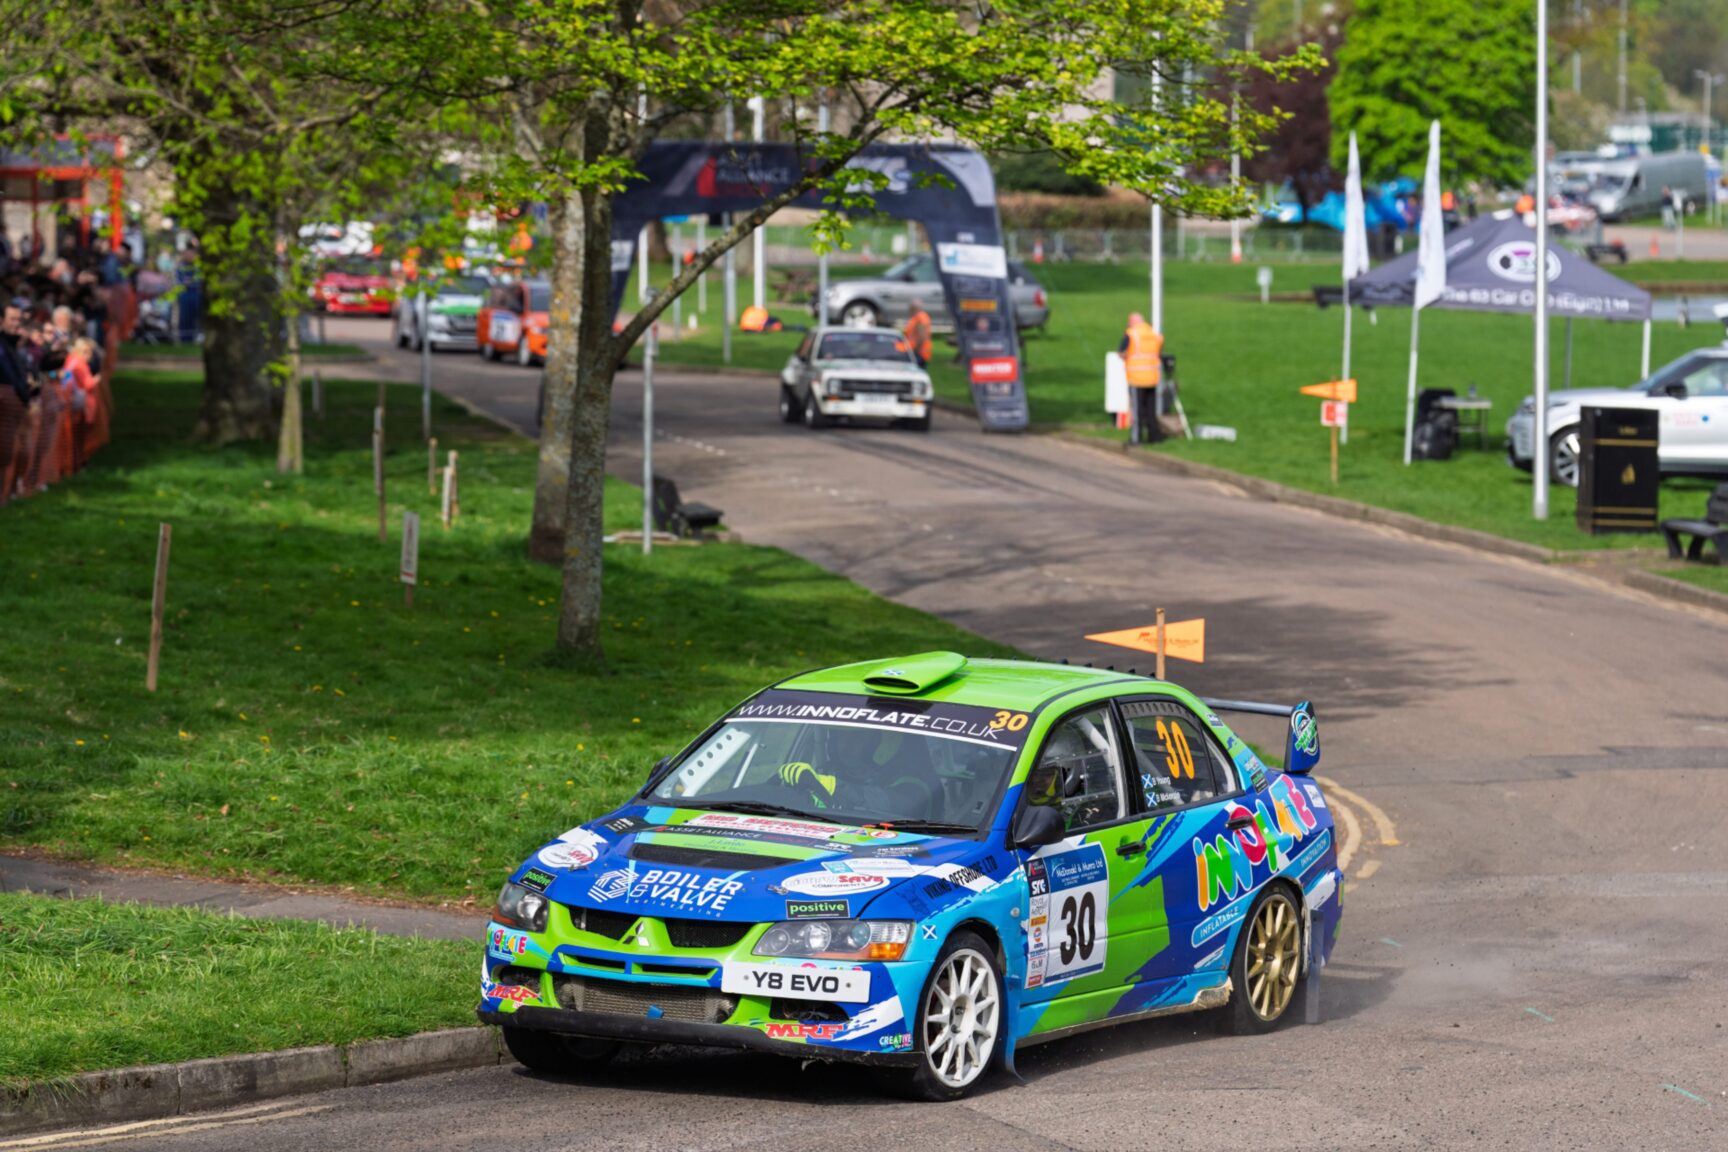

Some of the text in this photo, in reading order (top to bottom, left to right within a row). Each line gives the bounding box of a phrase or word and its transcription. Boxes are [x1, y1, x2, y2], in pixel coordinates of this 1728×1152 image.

[989, 711, 1030, 732] 30
[1156, 719, 1195, 780] 30
[701, 828, 763, 839] ALLIANCE
[641, 870, 744, 895] BOILER
[839, 875, 884, 883] SAVE
[949, 861, 984, 889] OFFSHORE
[982, 855, 998, 874] LTD
[649, 885, 733, 912] VALVE
[790, 902, 845, 914] positive
[1060, 891, 1096, 966] 30
[1200, 907, 1241, 938] INFLATABLE
[752, 971, 839, 993] Y8 EVO
[487, 984, 539, 1002] MRF
[766, 1023, 843, 1039] MRF
[879, 1033, 912, 1046] CREATIVE
